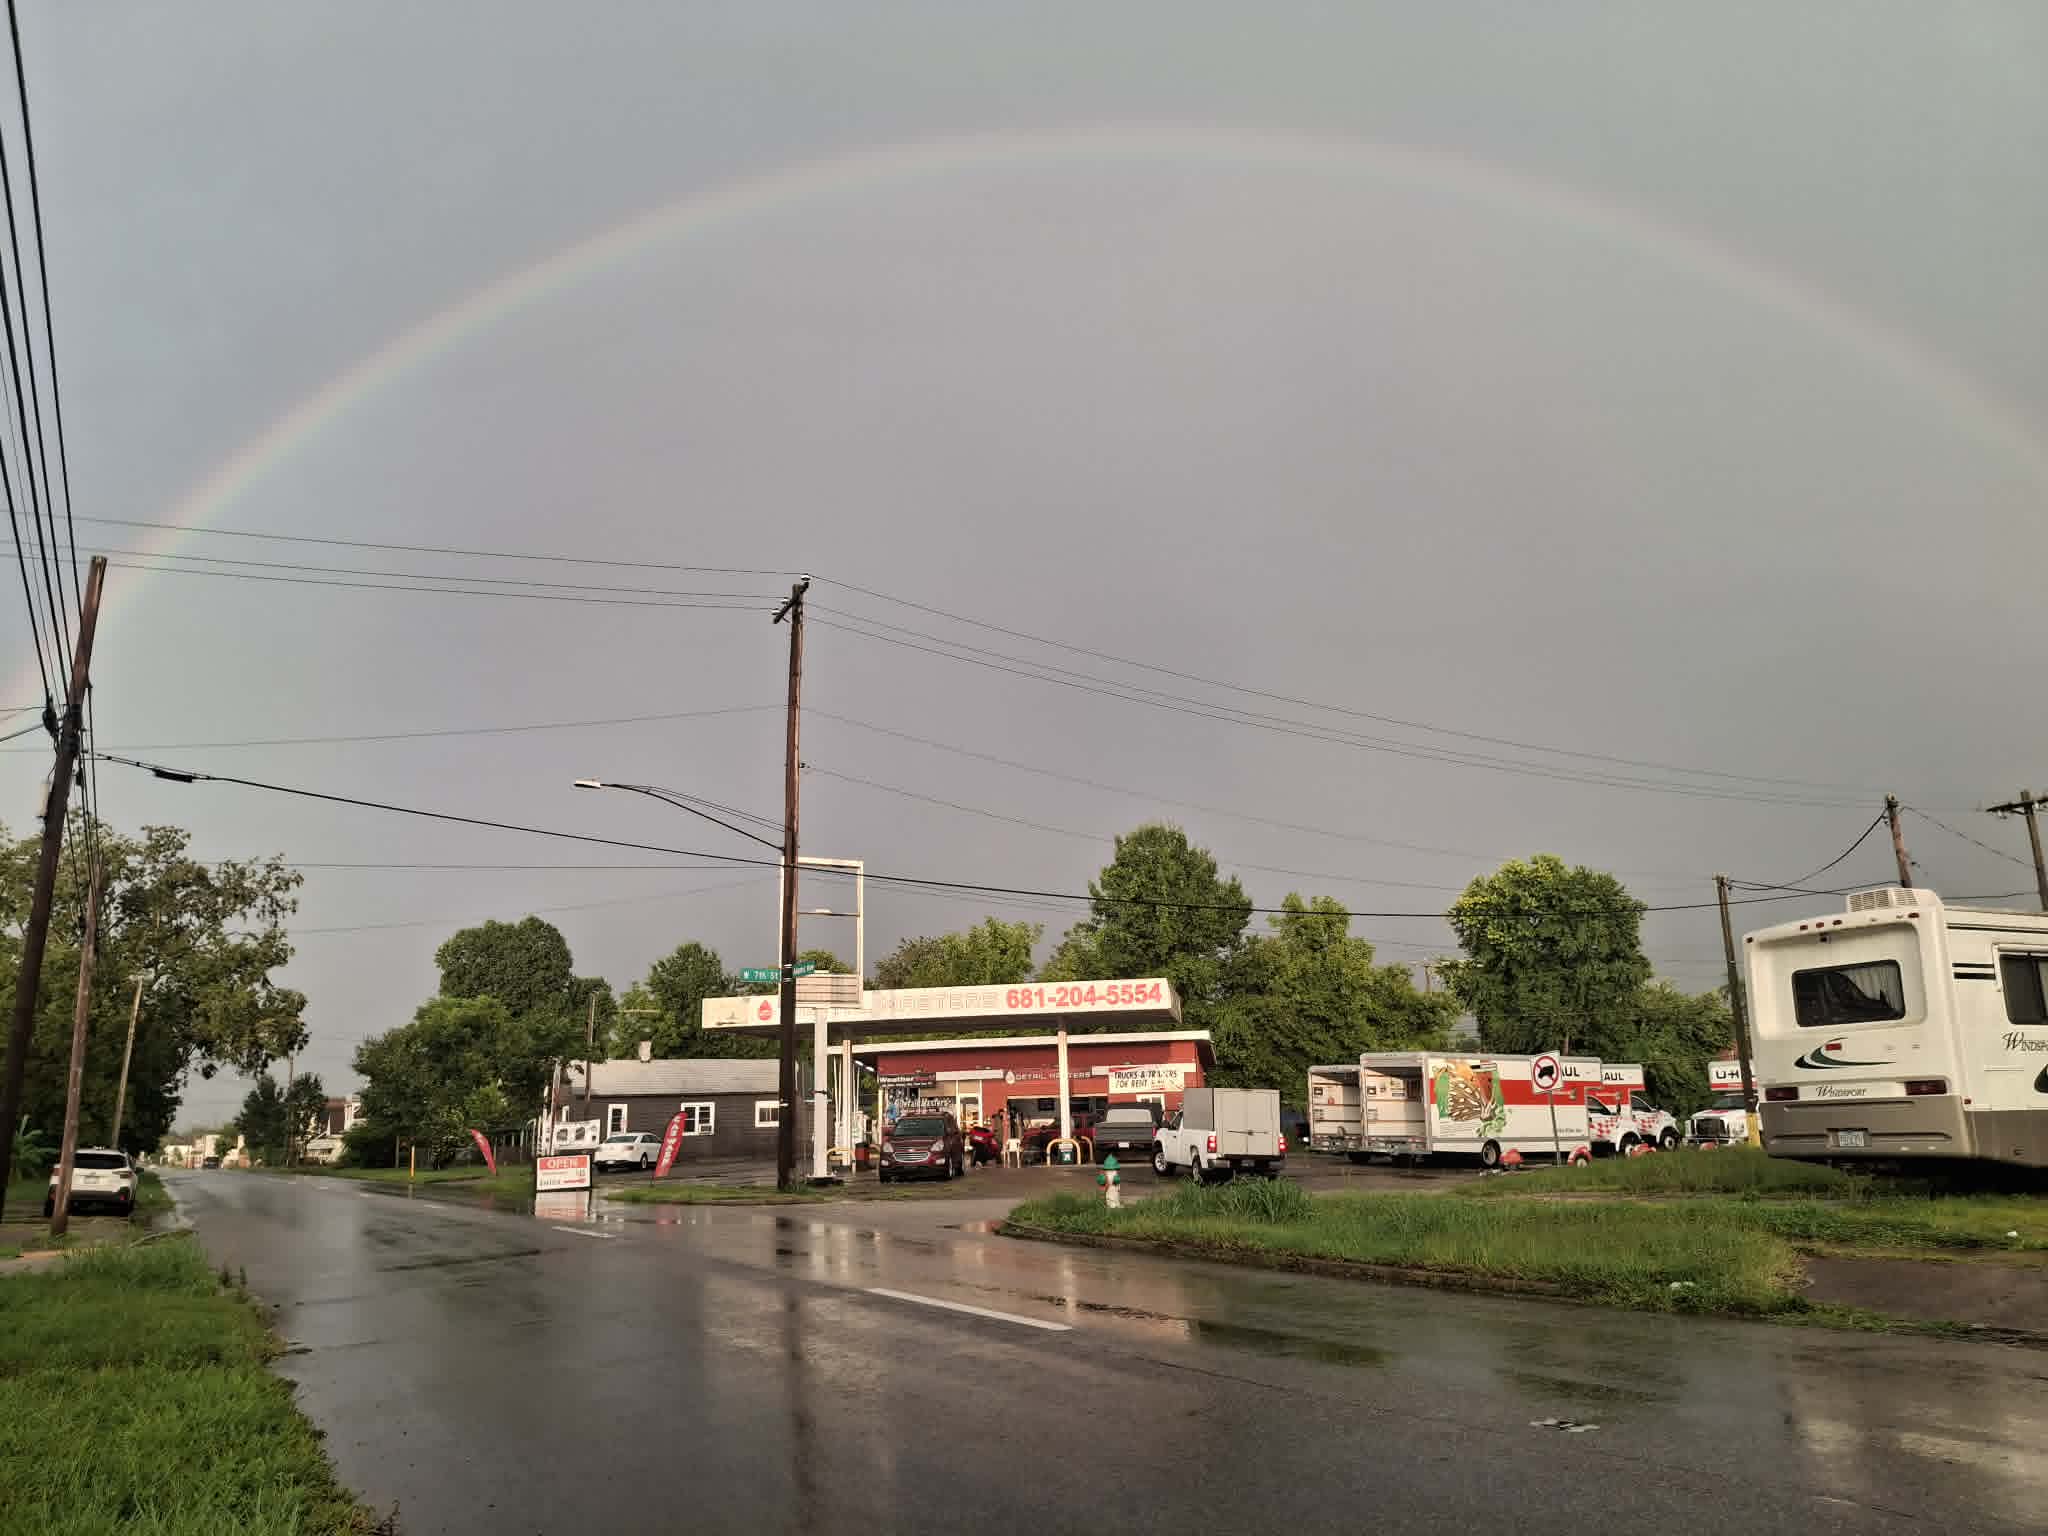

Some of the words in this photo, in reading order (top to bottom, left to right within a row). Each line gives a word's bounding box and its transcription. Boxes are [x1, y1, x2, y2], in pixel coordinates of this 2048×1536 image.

[743, 969, 750, 979] W
[753, 970, 767, 980] 7th
[769, 971, 779, 980] St
[1006, 983, 1163, 1009] 681-204-5554
[1049, 1071, 1091, 1080] MATERS
[1114, 1071, 1138, 1080] TRUCKS
[1130, 1079, 1148, 1089] RENT
